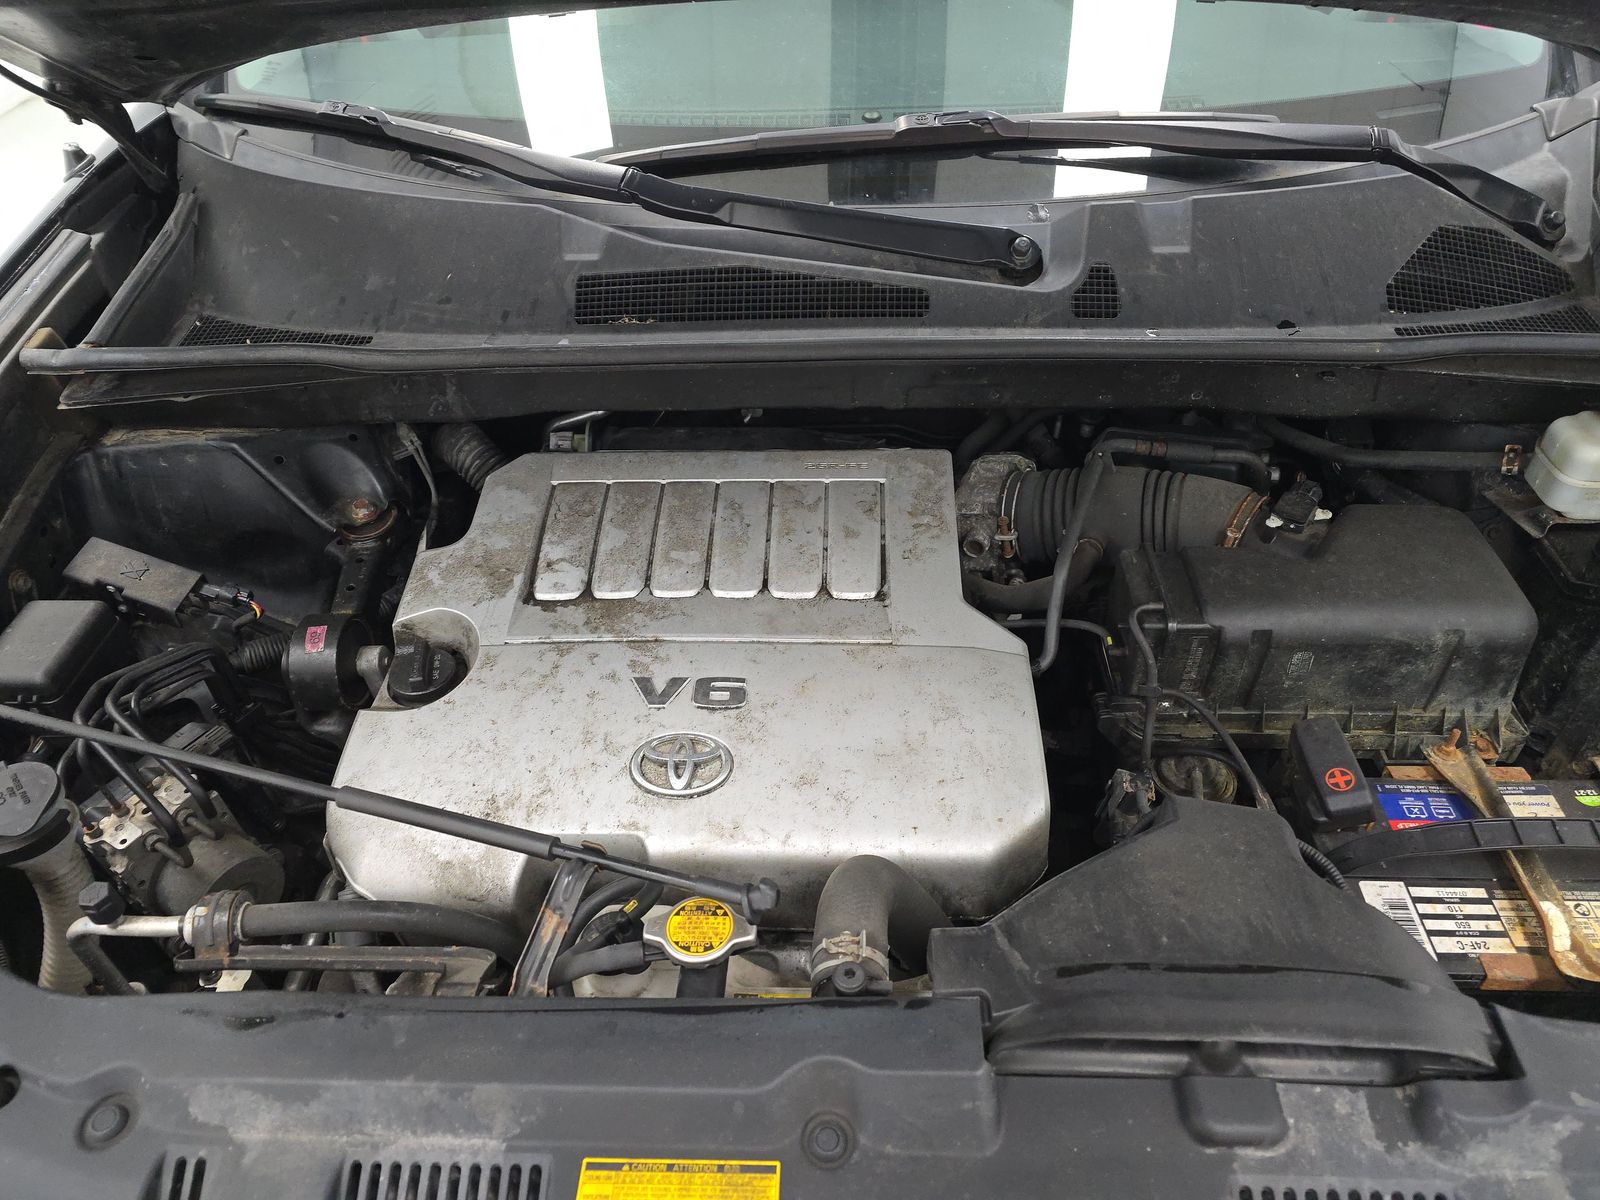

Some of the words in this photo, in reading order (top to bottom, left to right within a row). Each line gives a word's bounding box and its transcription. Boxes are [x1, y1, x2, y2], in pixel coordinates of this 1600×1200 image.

[432, 670, 440, 680] SAE
[631, 676, 748, 710] V6
[1447, 905, 1464, 913] 110
[1454, 921, 1471, 929] 650
[1456, 940, 1490, 950] 24F-C
[631, 1163, 668, 1172] CAUTION
[672, 1164, 718, 1173] ATTENTION
